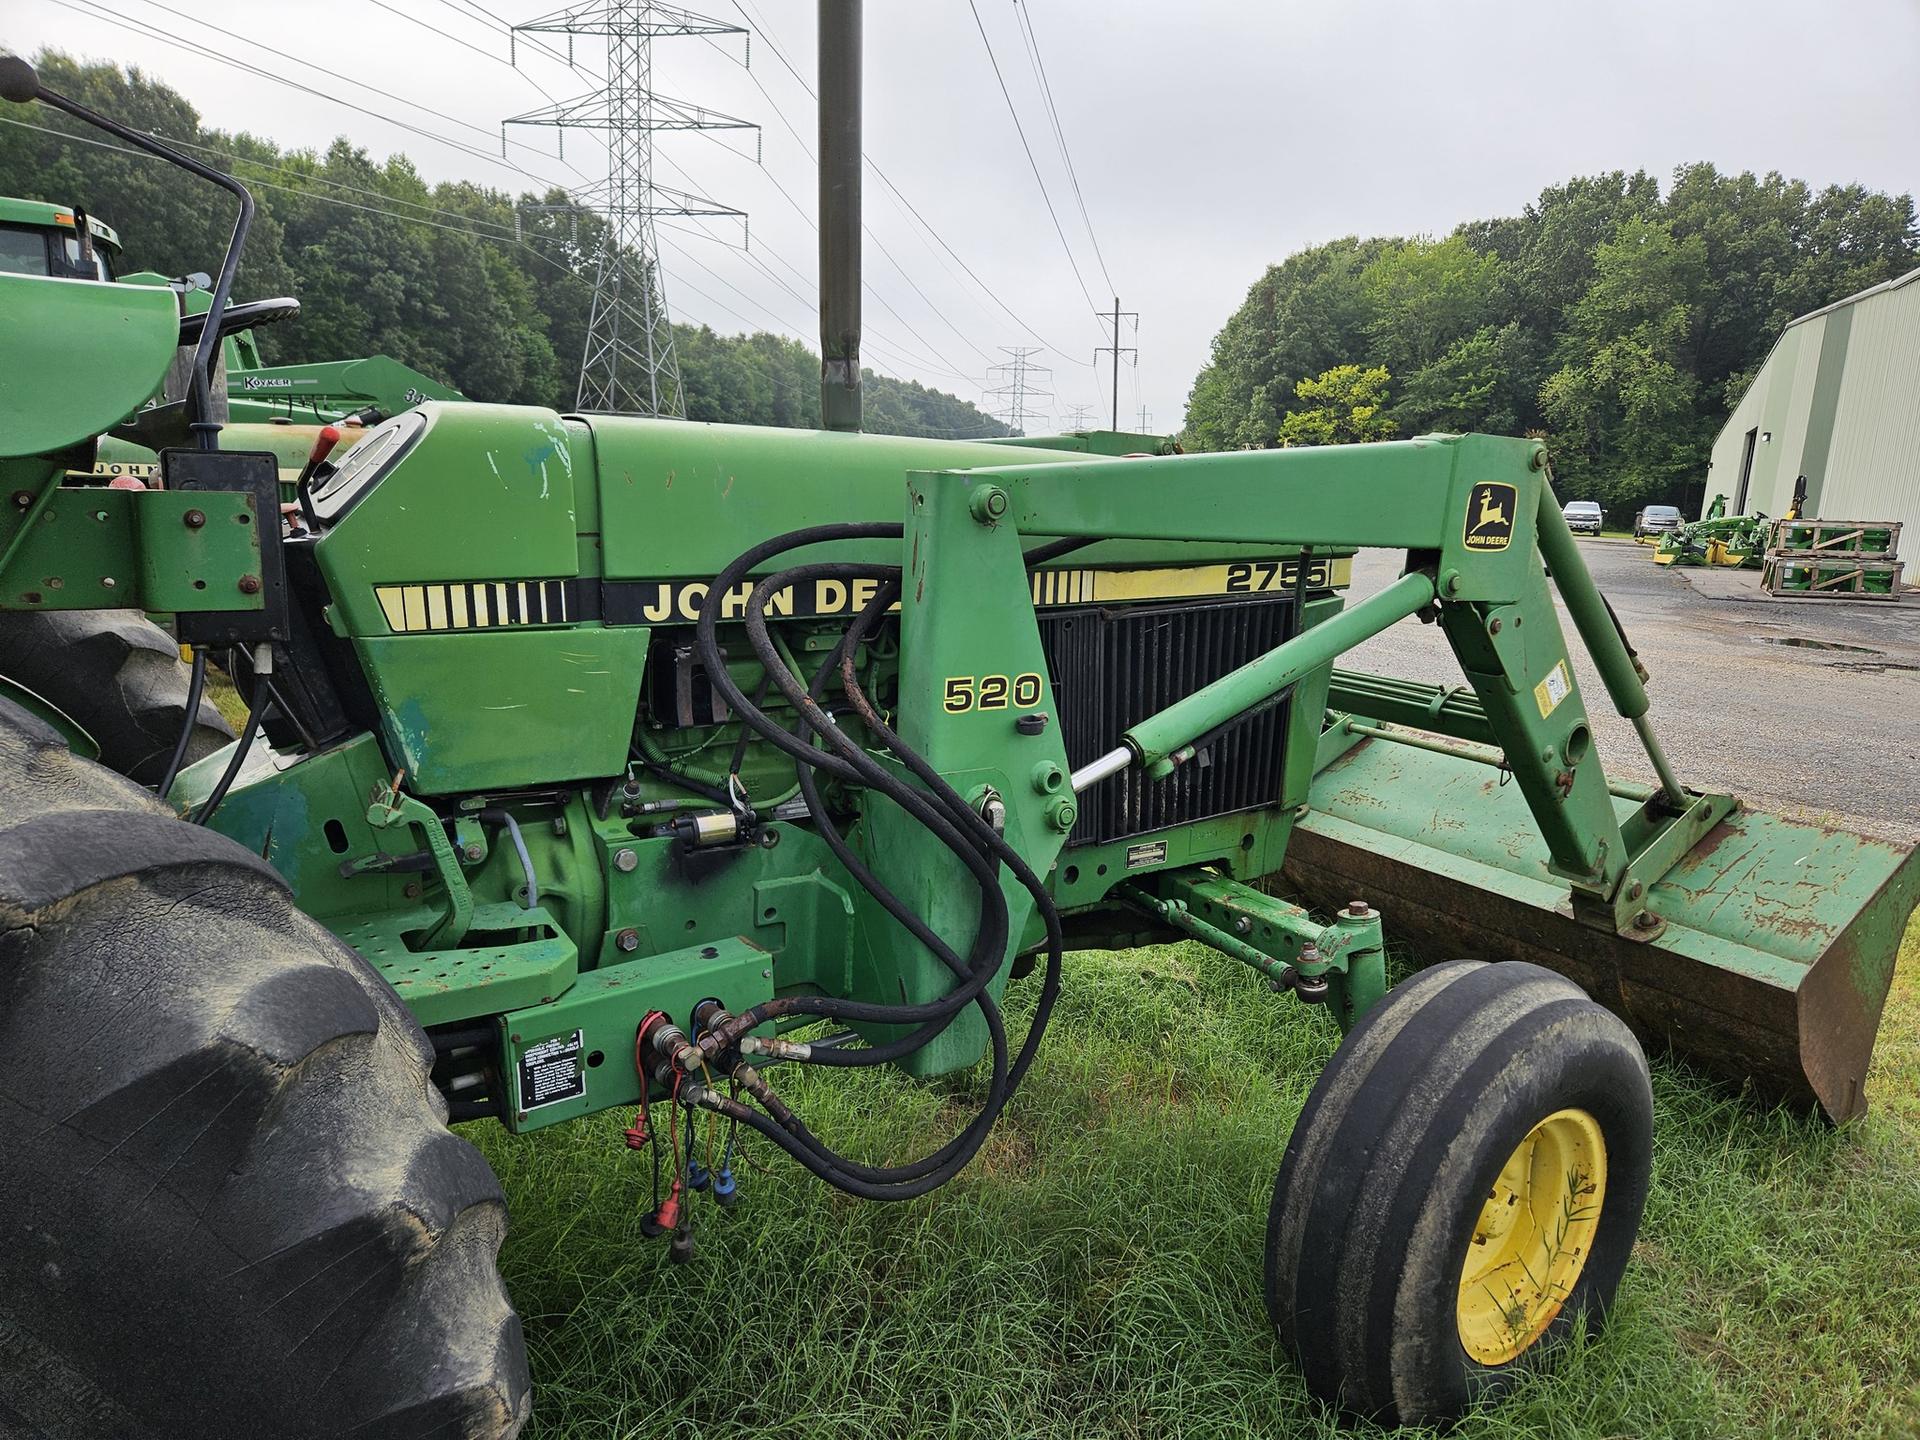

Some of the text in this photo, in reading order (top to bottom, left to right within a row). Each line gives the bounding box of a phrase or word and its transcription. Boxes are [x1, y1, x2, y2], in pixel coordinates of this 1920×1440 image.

[404, 387, 433, 405] 34
[1466, 535, 1508, 545] JOHN DEERE
[1226, 559, 1327, 593] 2755
[643, 582, 794, 622] JOHN
[943, 672, 1043, 714] 520
